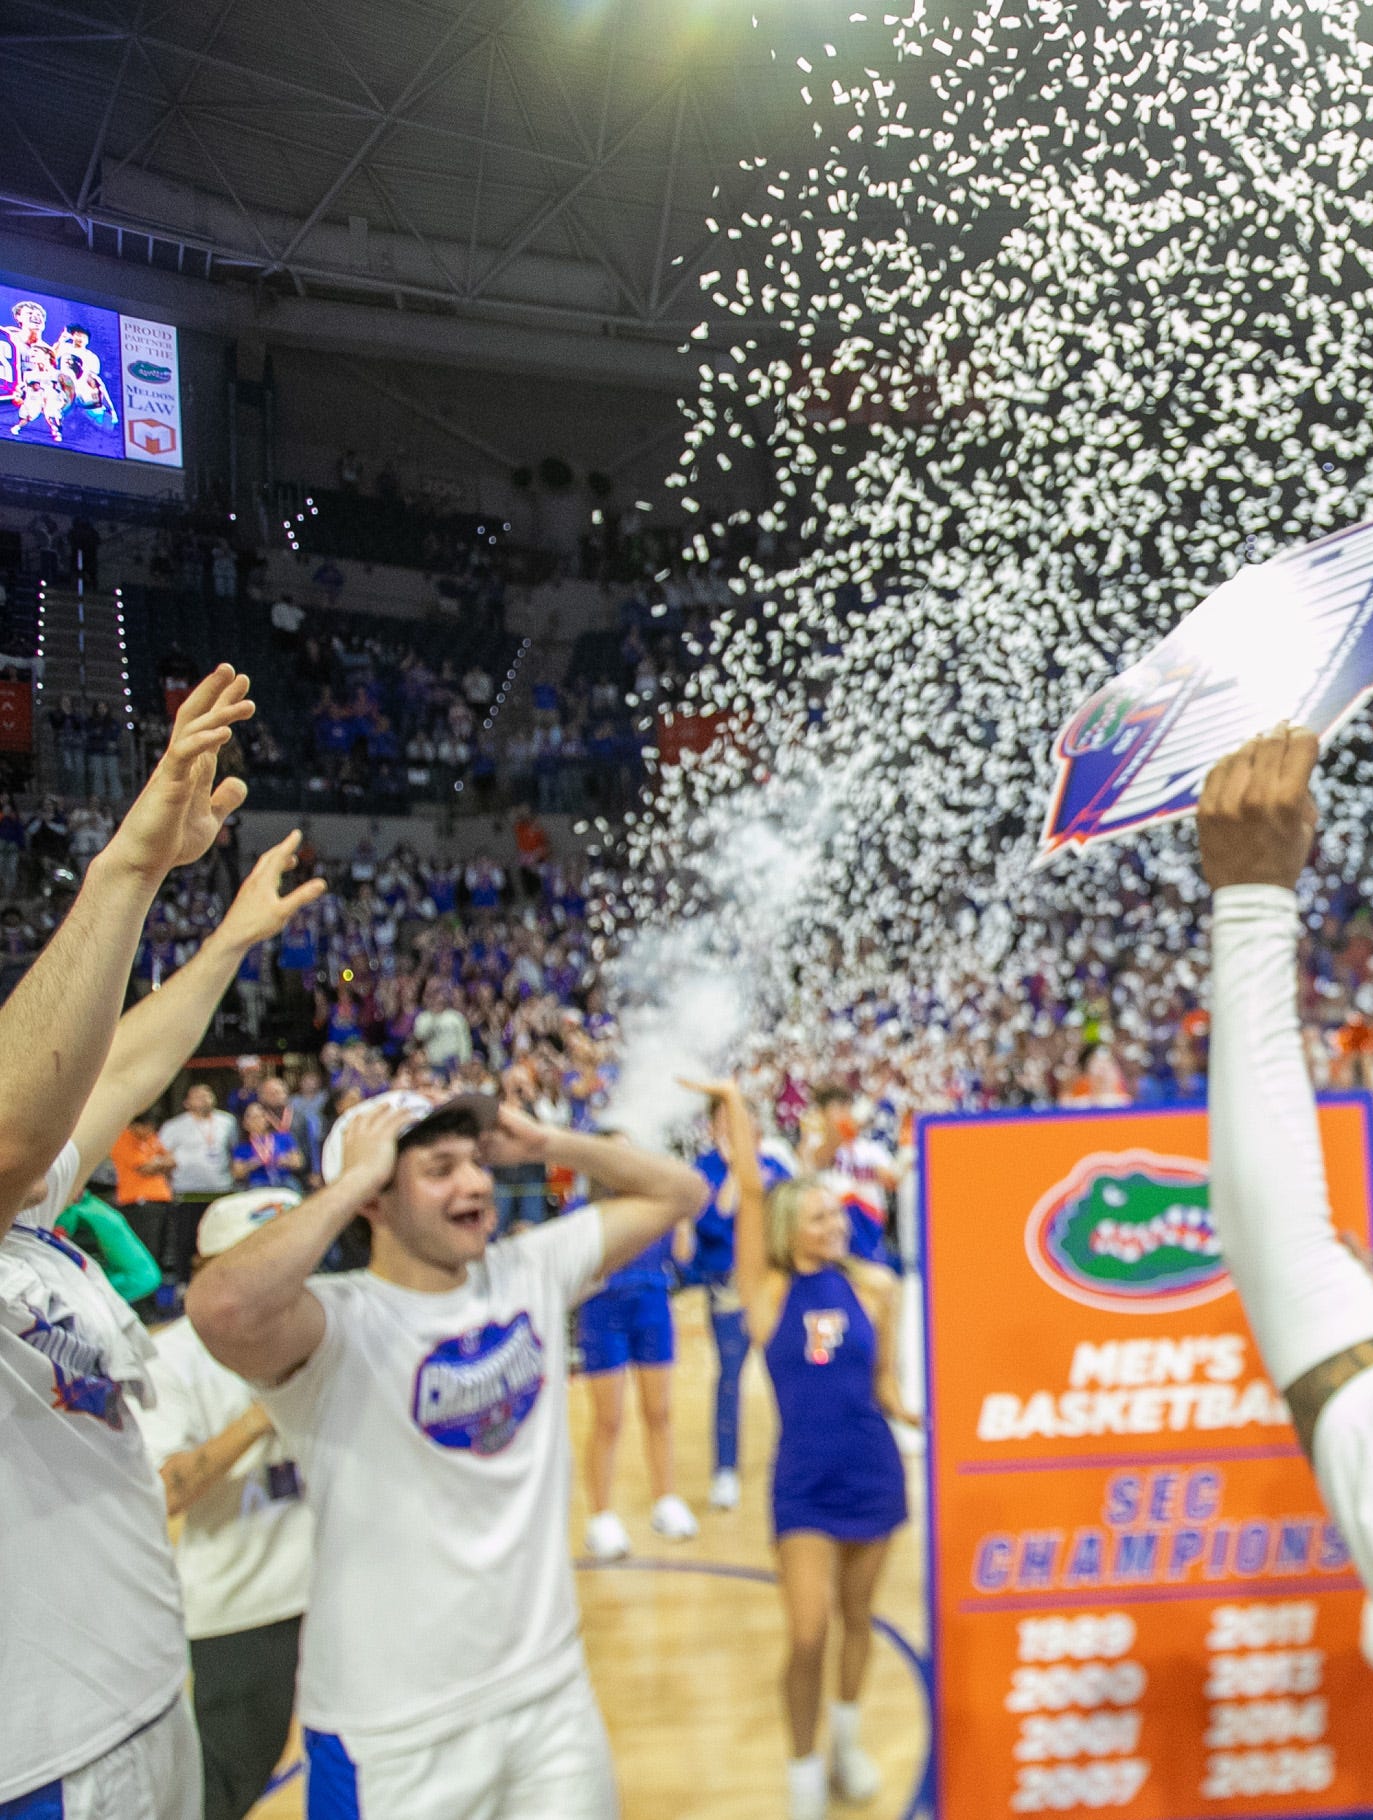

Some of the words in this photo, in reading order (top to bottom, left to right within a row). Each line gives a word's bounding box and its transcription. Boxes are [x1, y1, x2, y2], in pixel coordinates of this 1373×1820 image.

[124, 323, 172, 341] PROUD
[124, 333, 172, 350] PARTNER
[124, 343, 142, 353] OF
[145, 346, 172, 359] THE
[126, 384, 175, 401] MELDON
[127, 394, 175, 415] LAW
[1069, 1335, 1244, 1388] MEN'S
[977, 1380, 1290, 1440] BASKETBA
[1104, 1467, 1224, 1528] SEC
[973, 1512, 1351, 1593] CHAMPIONS
